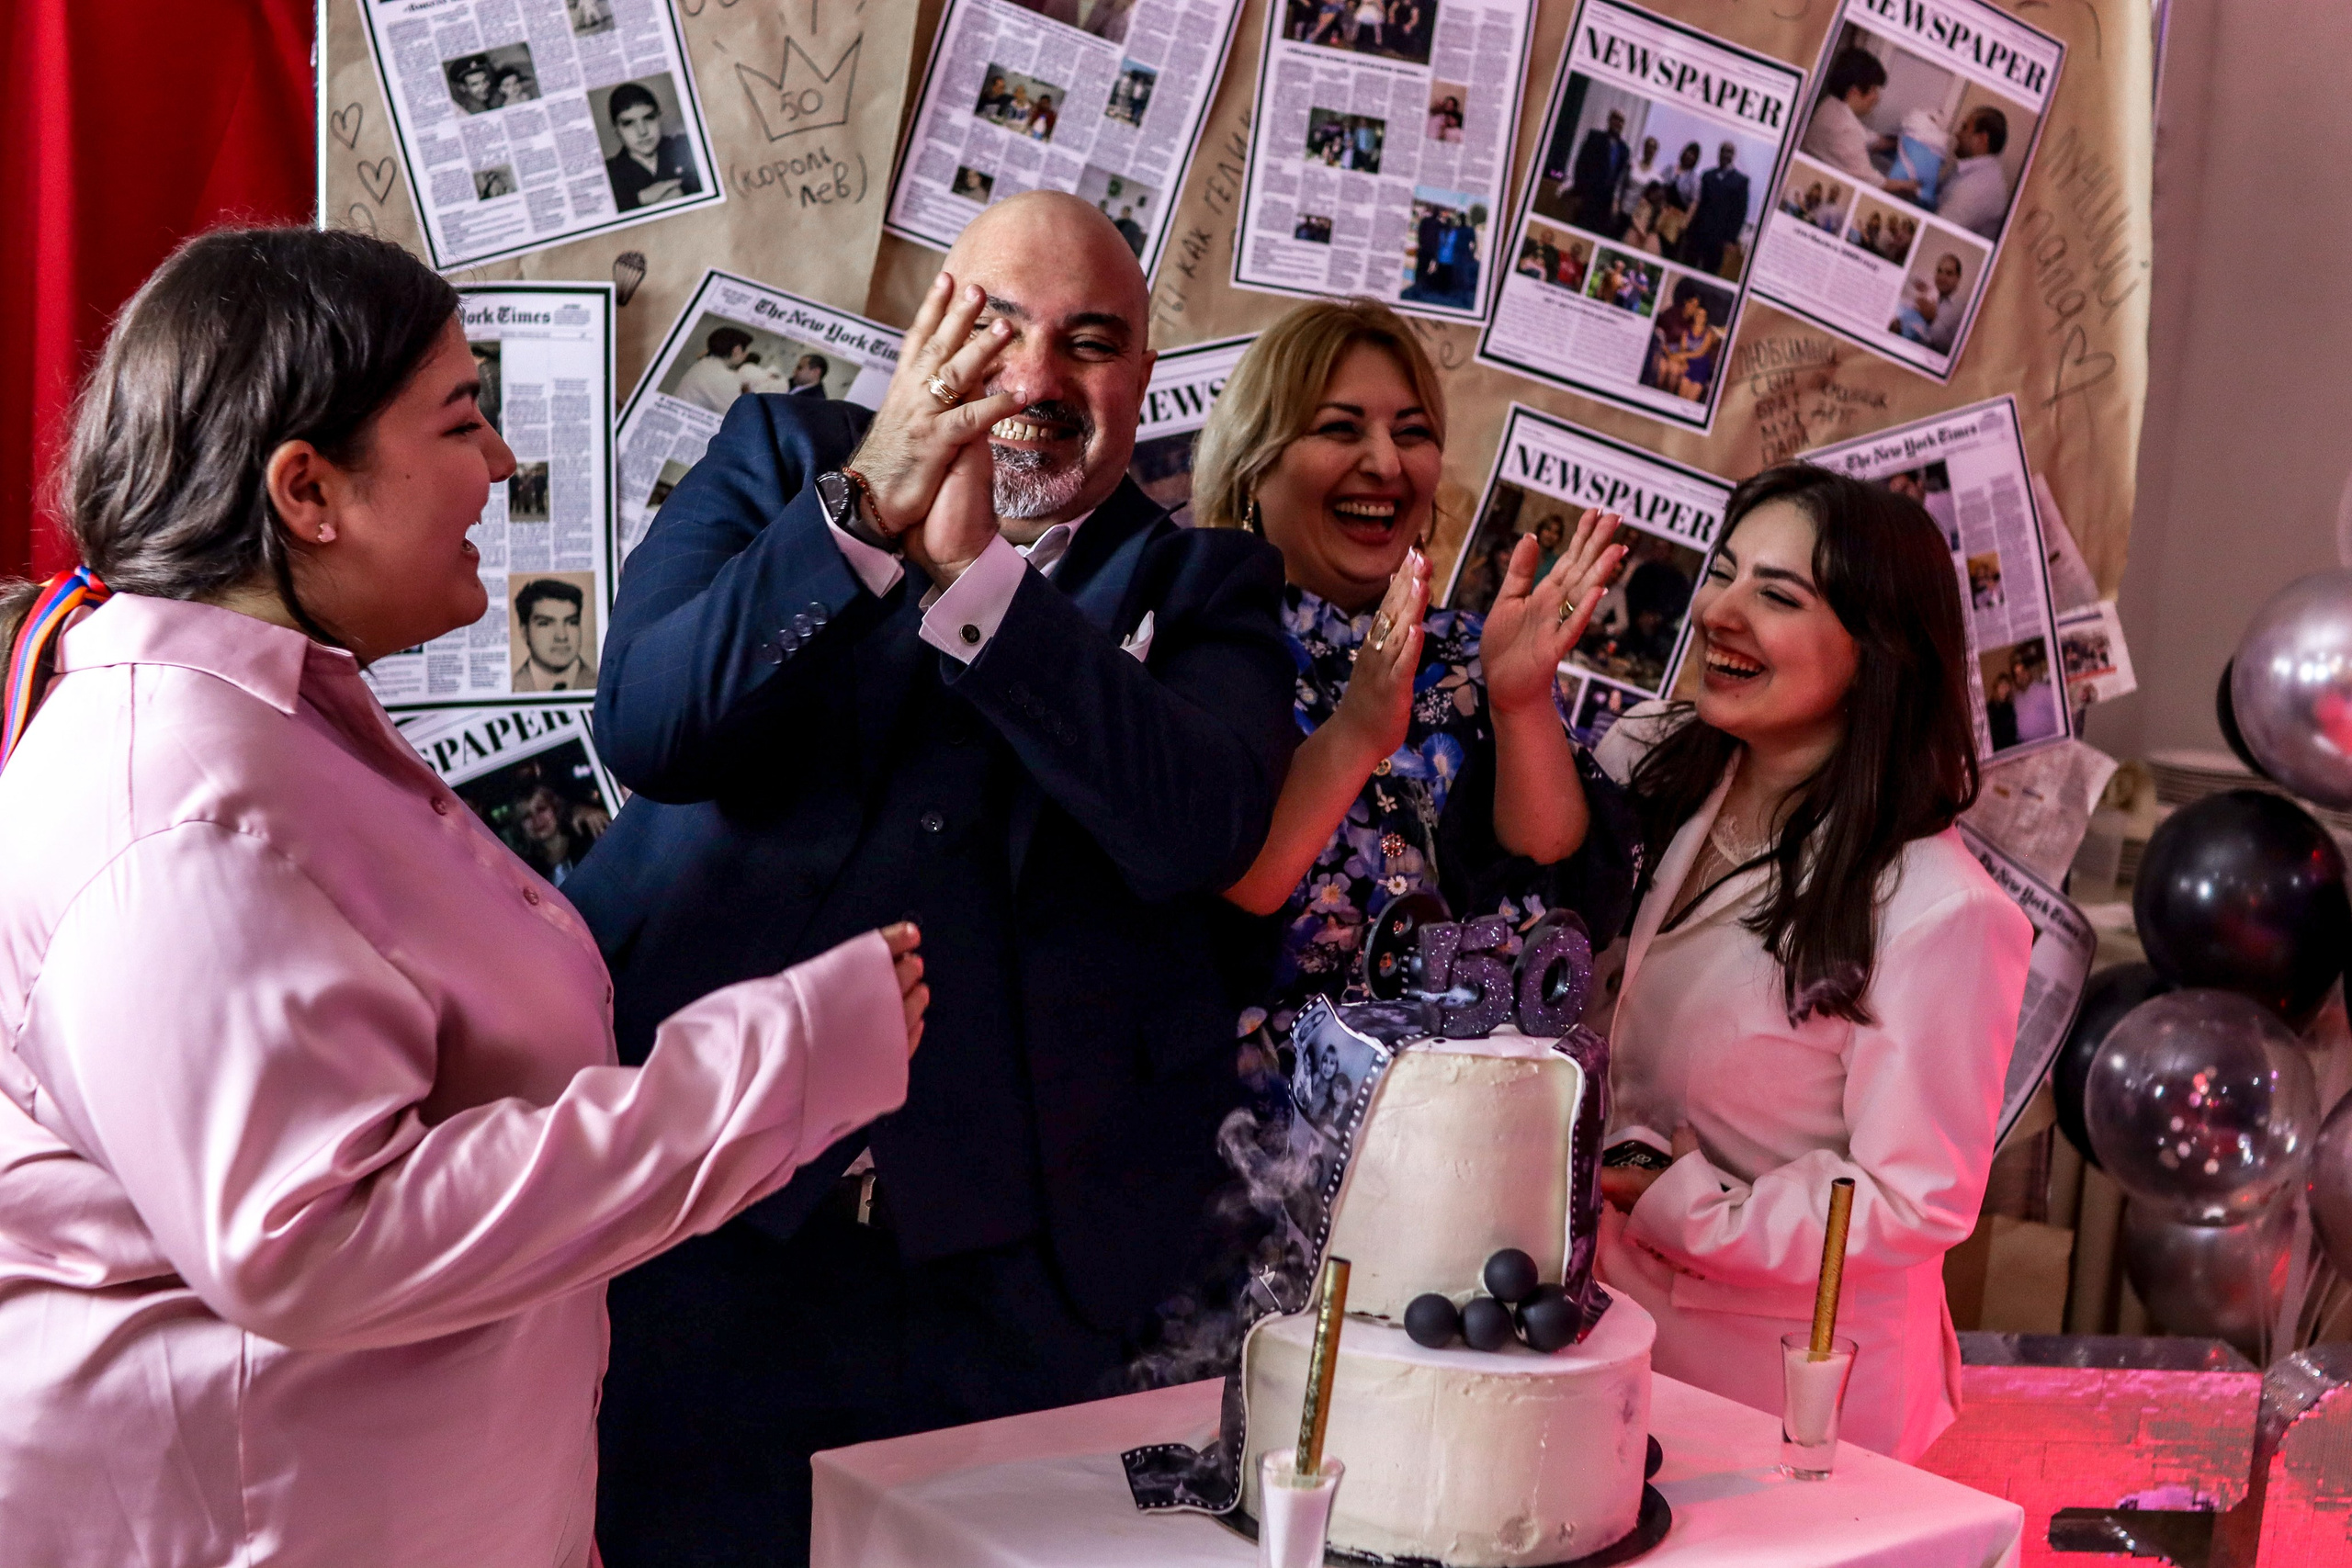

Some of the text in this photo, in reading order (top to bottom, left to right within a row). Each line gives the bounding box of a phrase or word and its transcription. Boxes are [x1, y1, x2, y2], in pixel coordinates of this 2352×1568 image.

[1577, 25, 1784, 129] NEWSPAPER
[1863, 0, 2047, 94] EWSPAPER
[780, 87, 823, 121] 50
[1176, 229, 1212, 278] КАК
[461, 306, 494, 326] ork
[497, 304, 551, 325] Times
[754, 298, 900, 362] The New York Tim
[1510, 442, 1716, 543] NEWSPAPER
[1419, 918, 1594, 1040] 50
